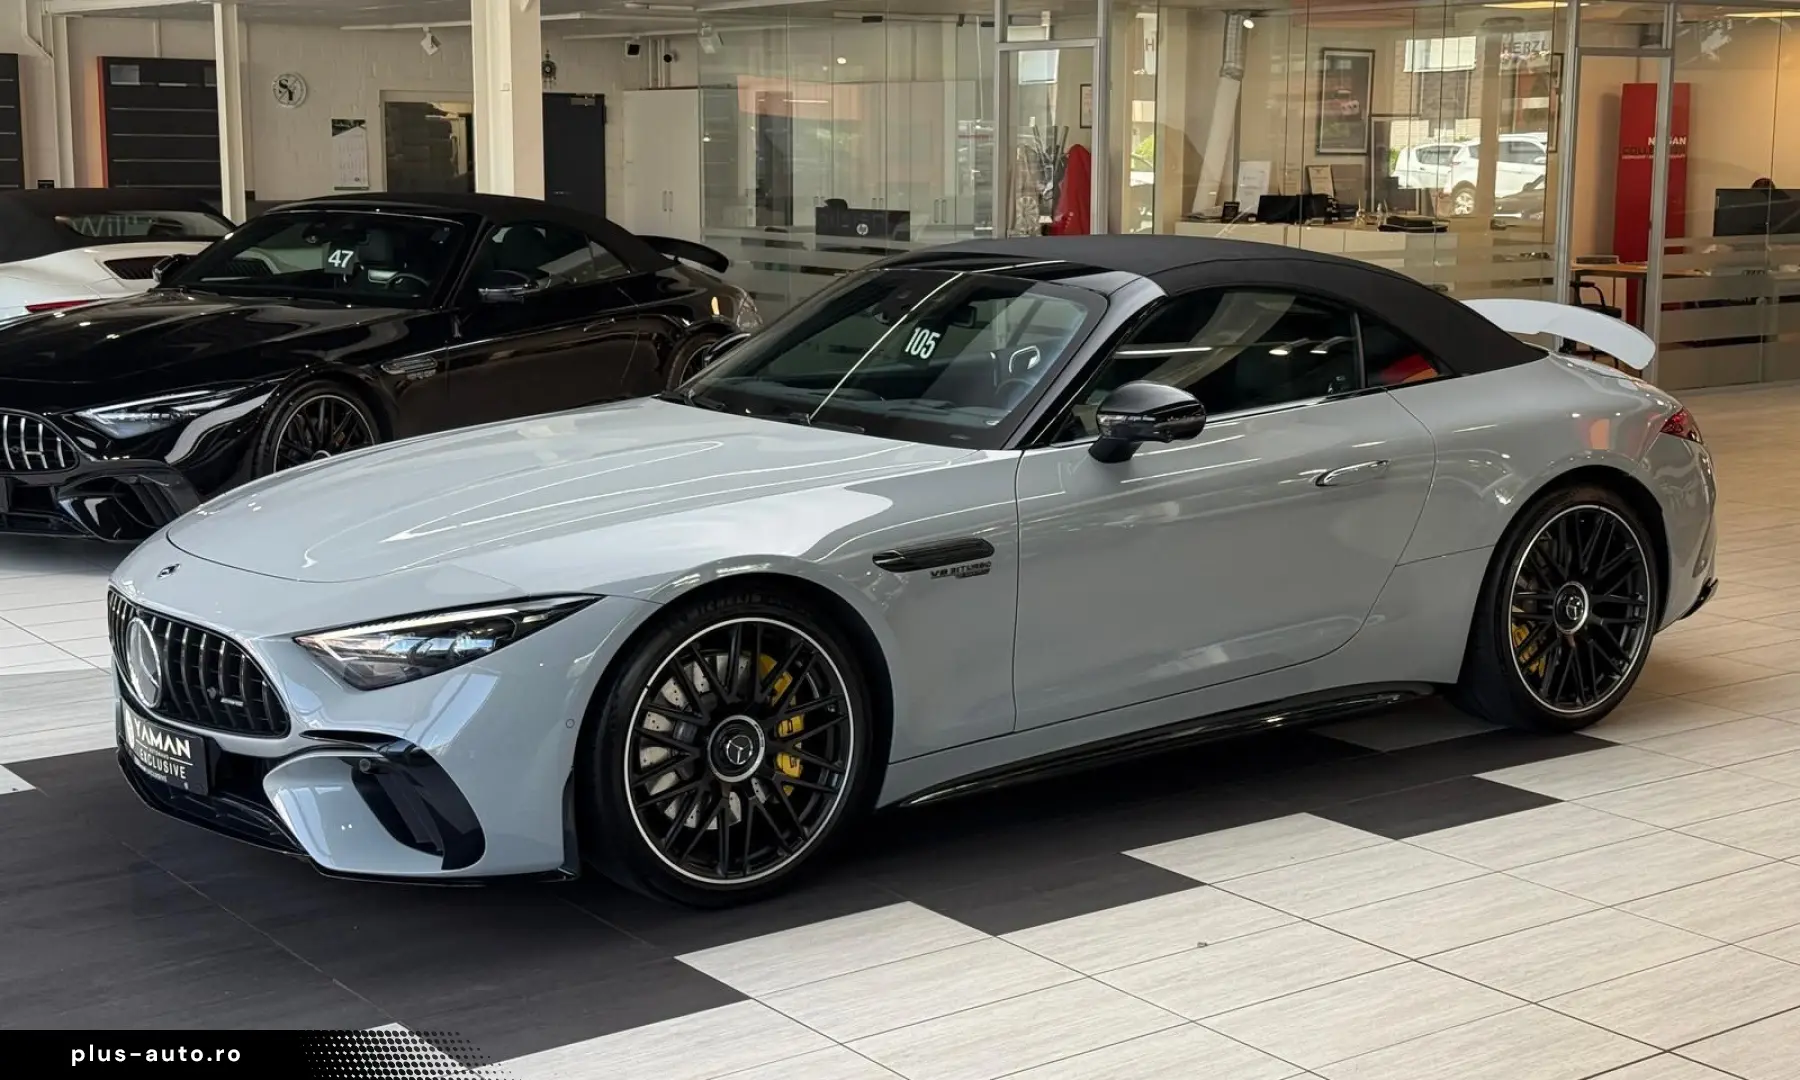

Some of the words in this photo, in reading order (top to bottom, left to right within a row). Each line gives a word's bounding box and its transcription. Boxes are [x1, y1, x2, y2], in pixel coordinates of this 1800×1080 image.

[328, 249, 354, 268] 47
[905, 327, 941, 359] 105
[134, 718, 191, 759] YAMAN
[140, 748, 187, 780] EXCLUSIVE
